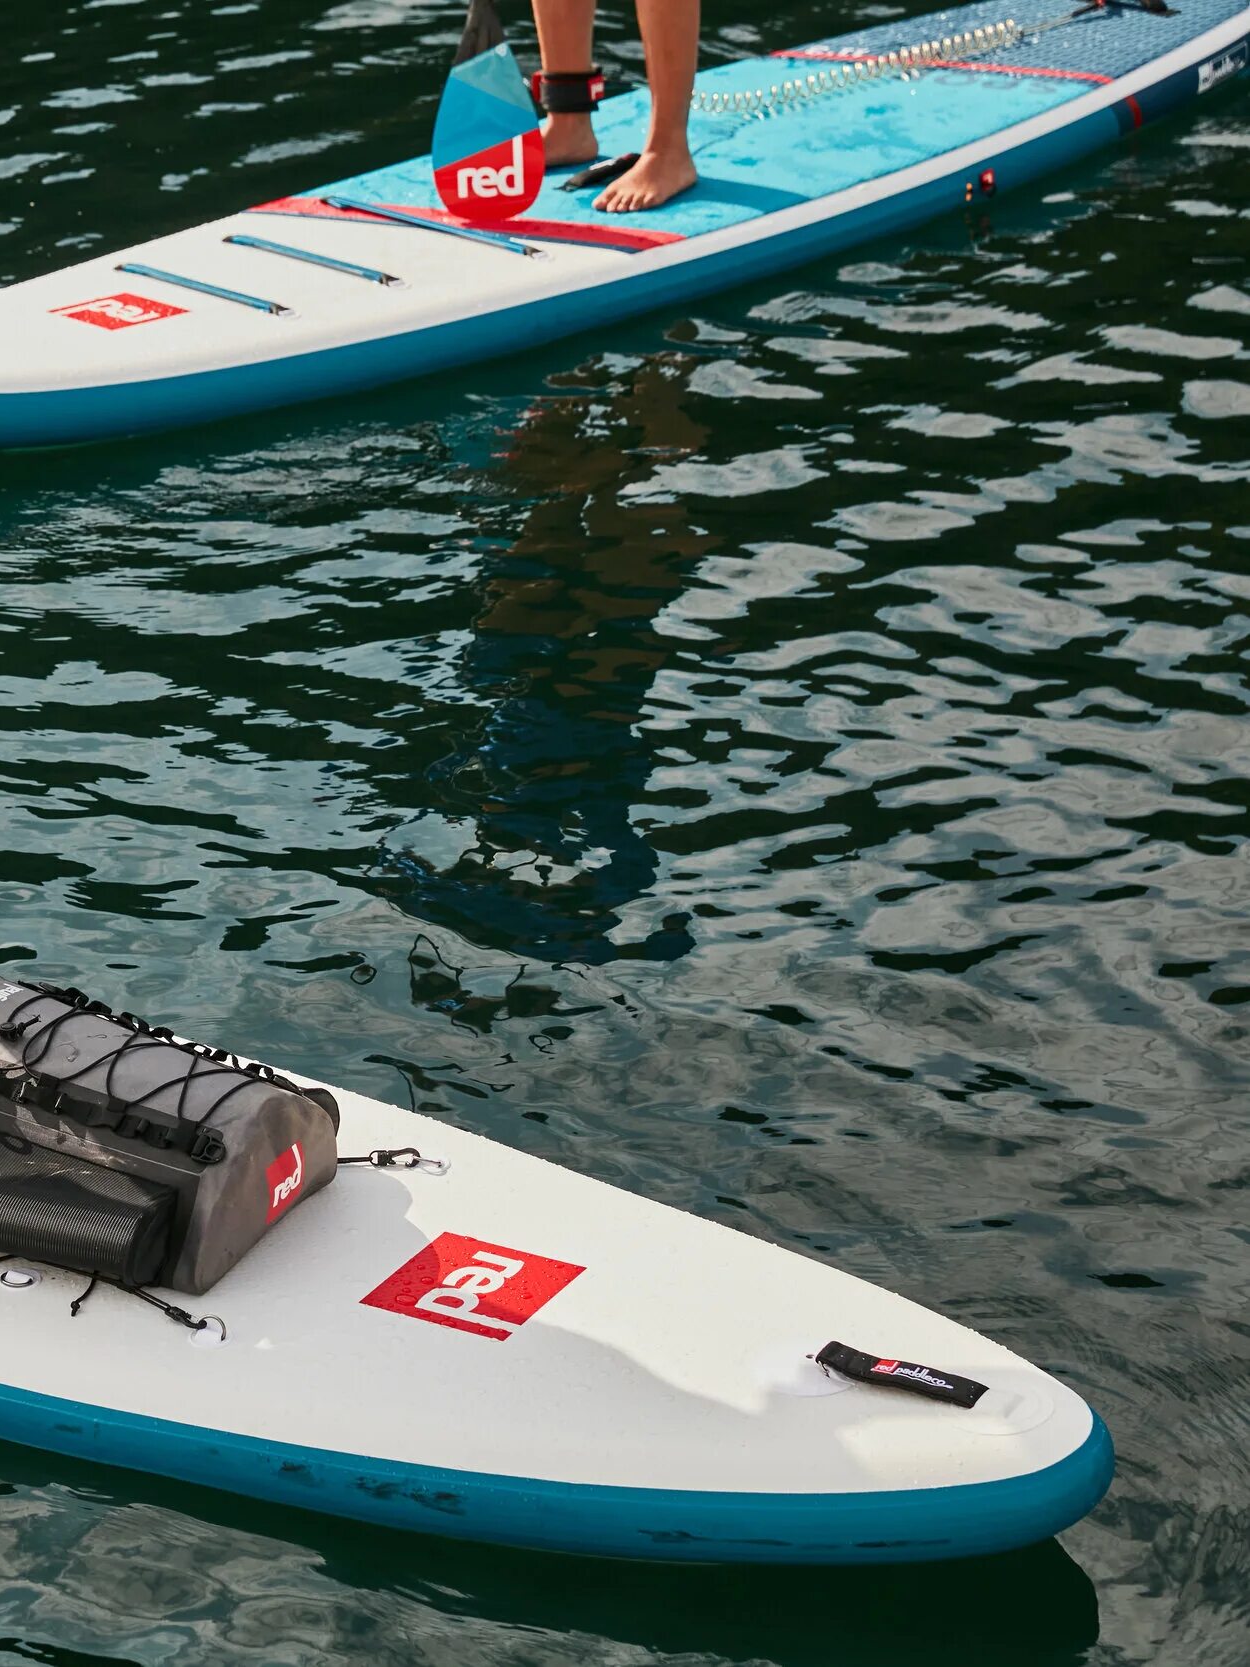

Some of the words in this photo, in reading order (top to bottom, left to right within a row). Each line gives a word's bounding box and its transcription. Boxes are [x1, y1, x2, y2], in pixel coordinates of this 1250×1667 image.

[456, 135, 525, 198] red
[273, 1143, 302, 1209] red
[414, 1250, 525, 1334] red
[875, 1361, 899, 1372] red
[895, 1366, 947, 1387] paddleco
